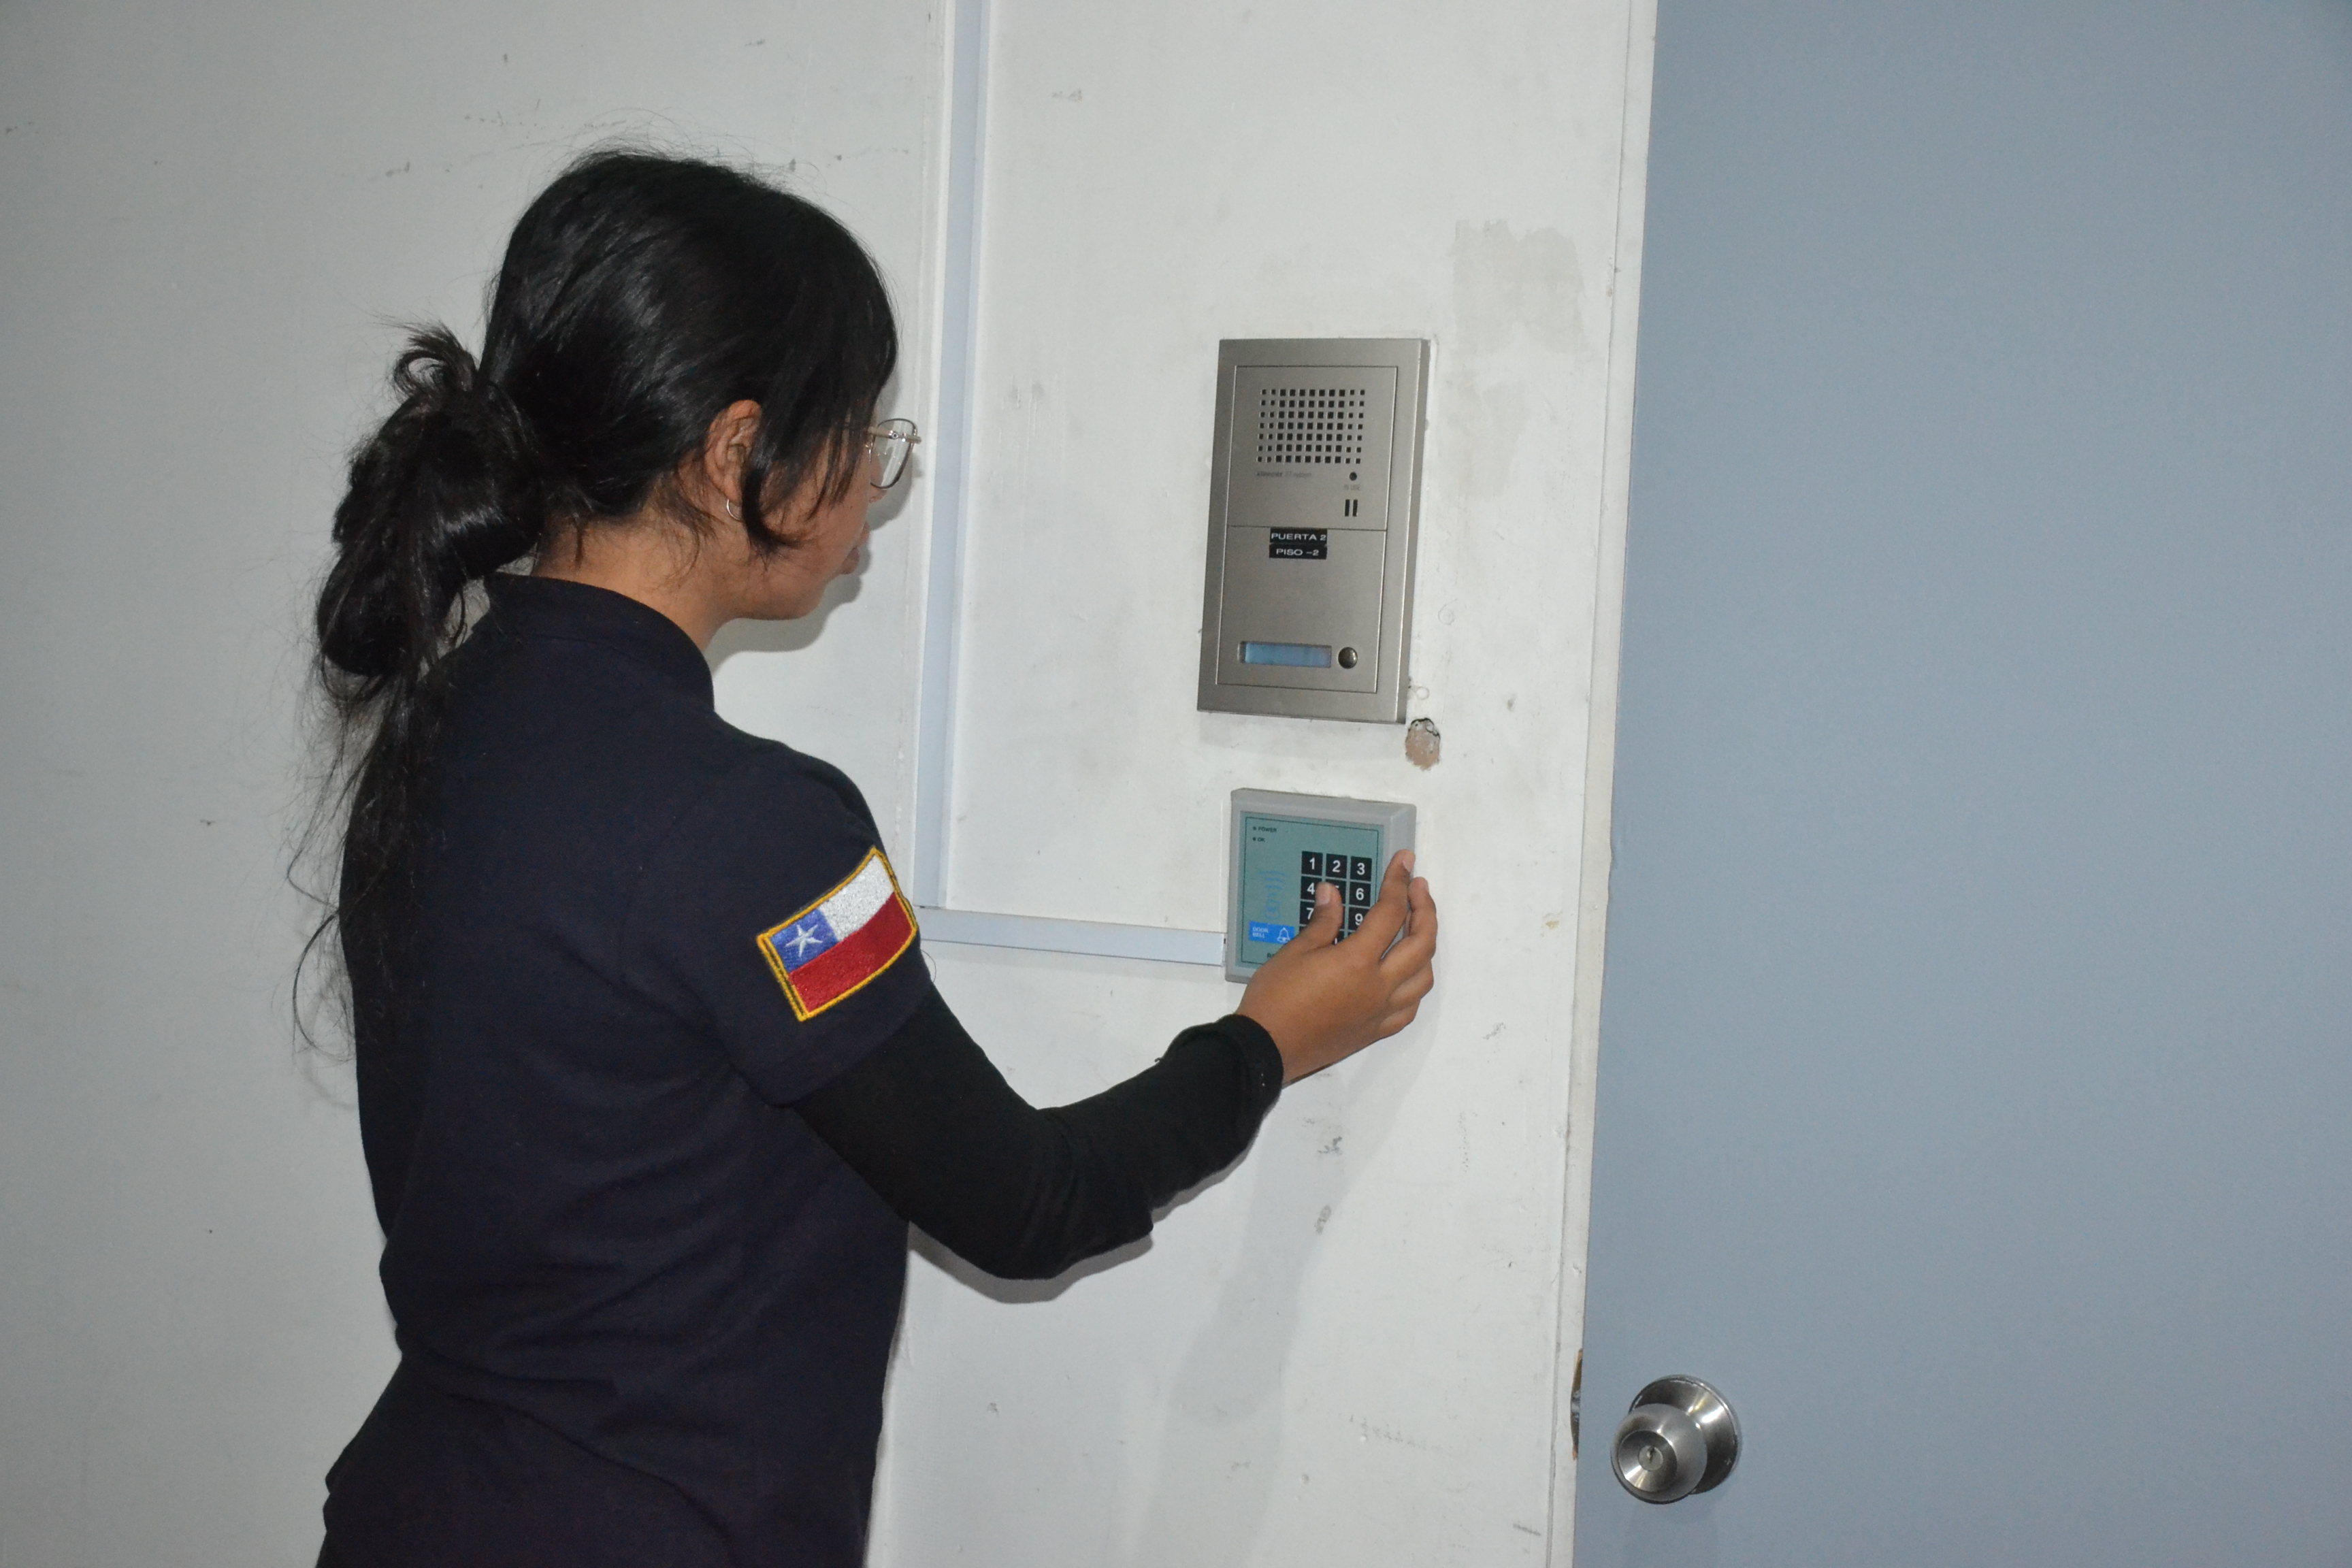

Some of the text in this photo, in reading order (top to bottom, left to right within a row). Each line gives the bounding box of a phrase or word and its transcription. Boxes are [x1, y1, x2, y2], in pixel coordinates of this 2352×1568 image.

[1271, 533, 1317, 541] PUERTA
[1309, 858, 1365, 875] 1 2 3
[1307, 882, 1365, 900] 4 6
[1307, 907, 1363, 926] 7 9
